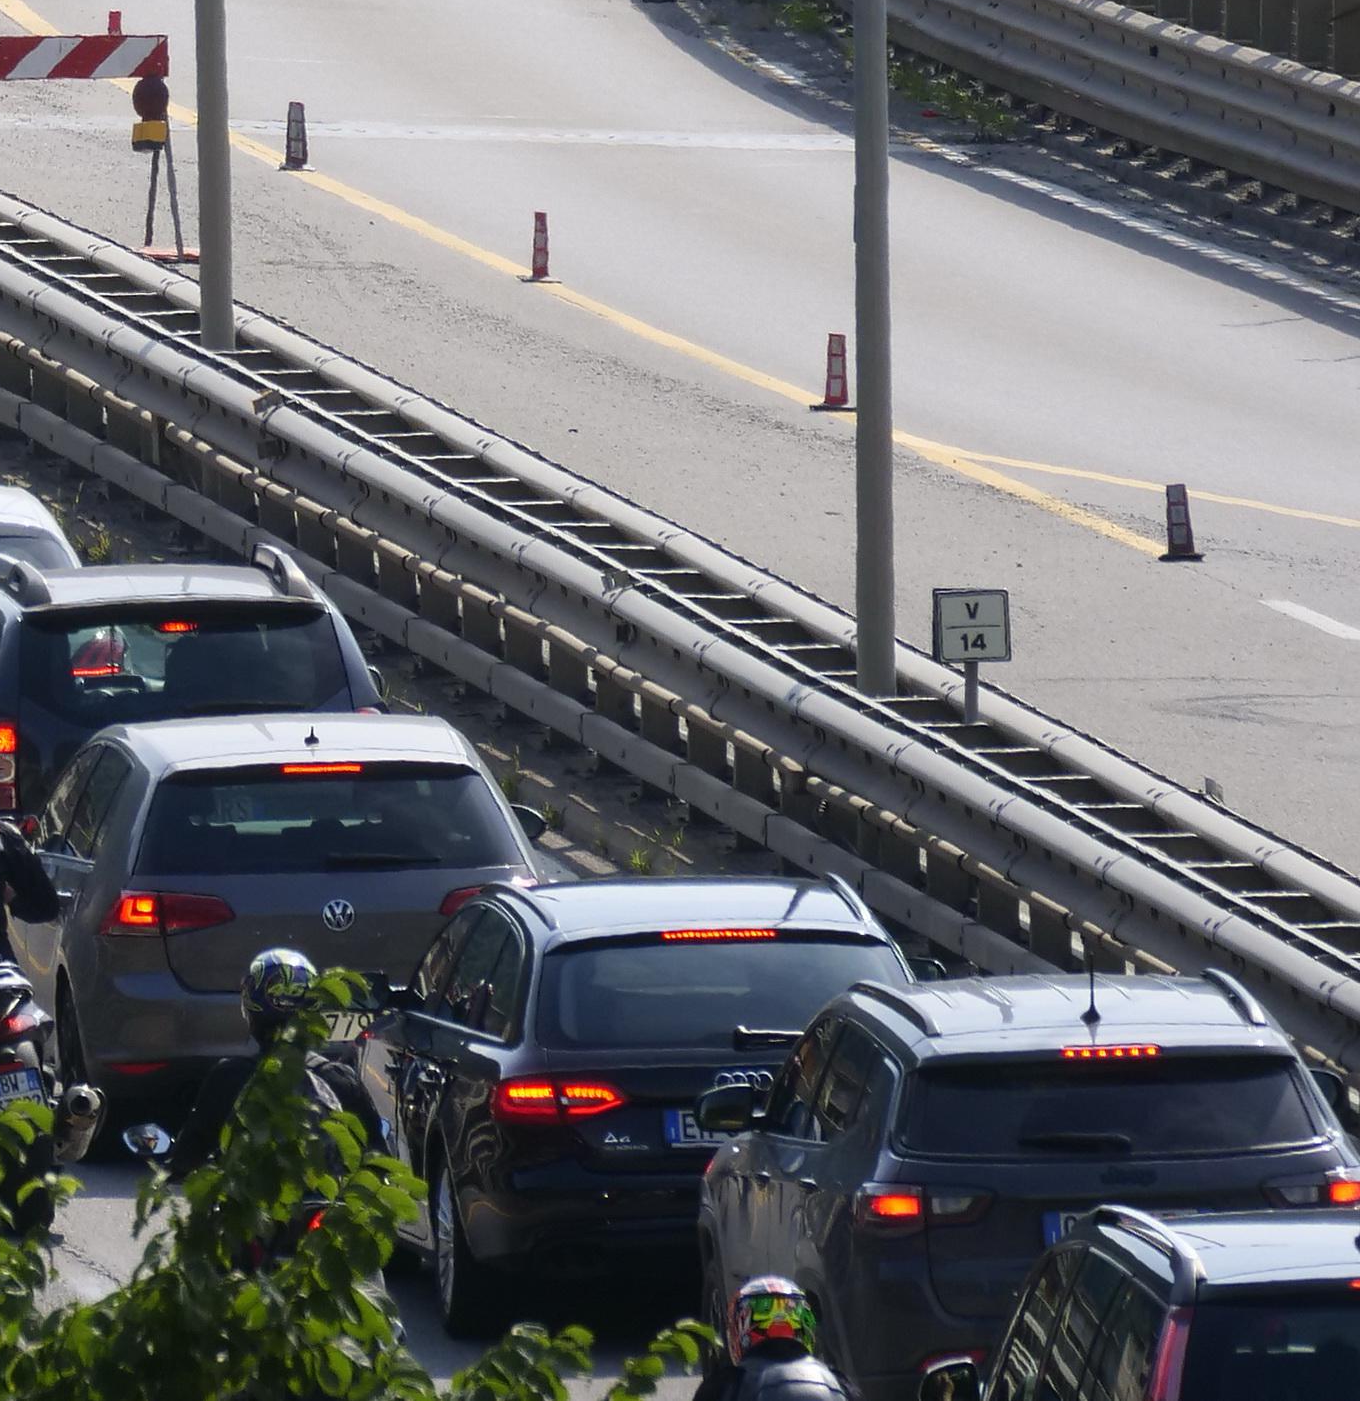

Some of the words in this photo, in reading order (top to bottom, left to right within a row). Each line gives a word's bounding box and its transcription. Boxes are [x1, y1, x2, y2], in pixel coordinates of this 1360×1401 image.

[965, 602, 979, 620] V
[960, 633, 987, 652] 14
[0, 1076, 19, 1094] BW
